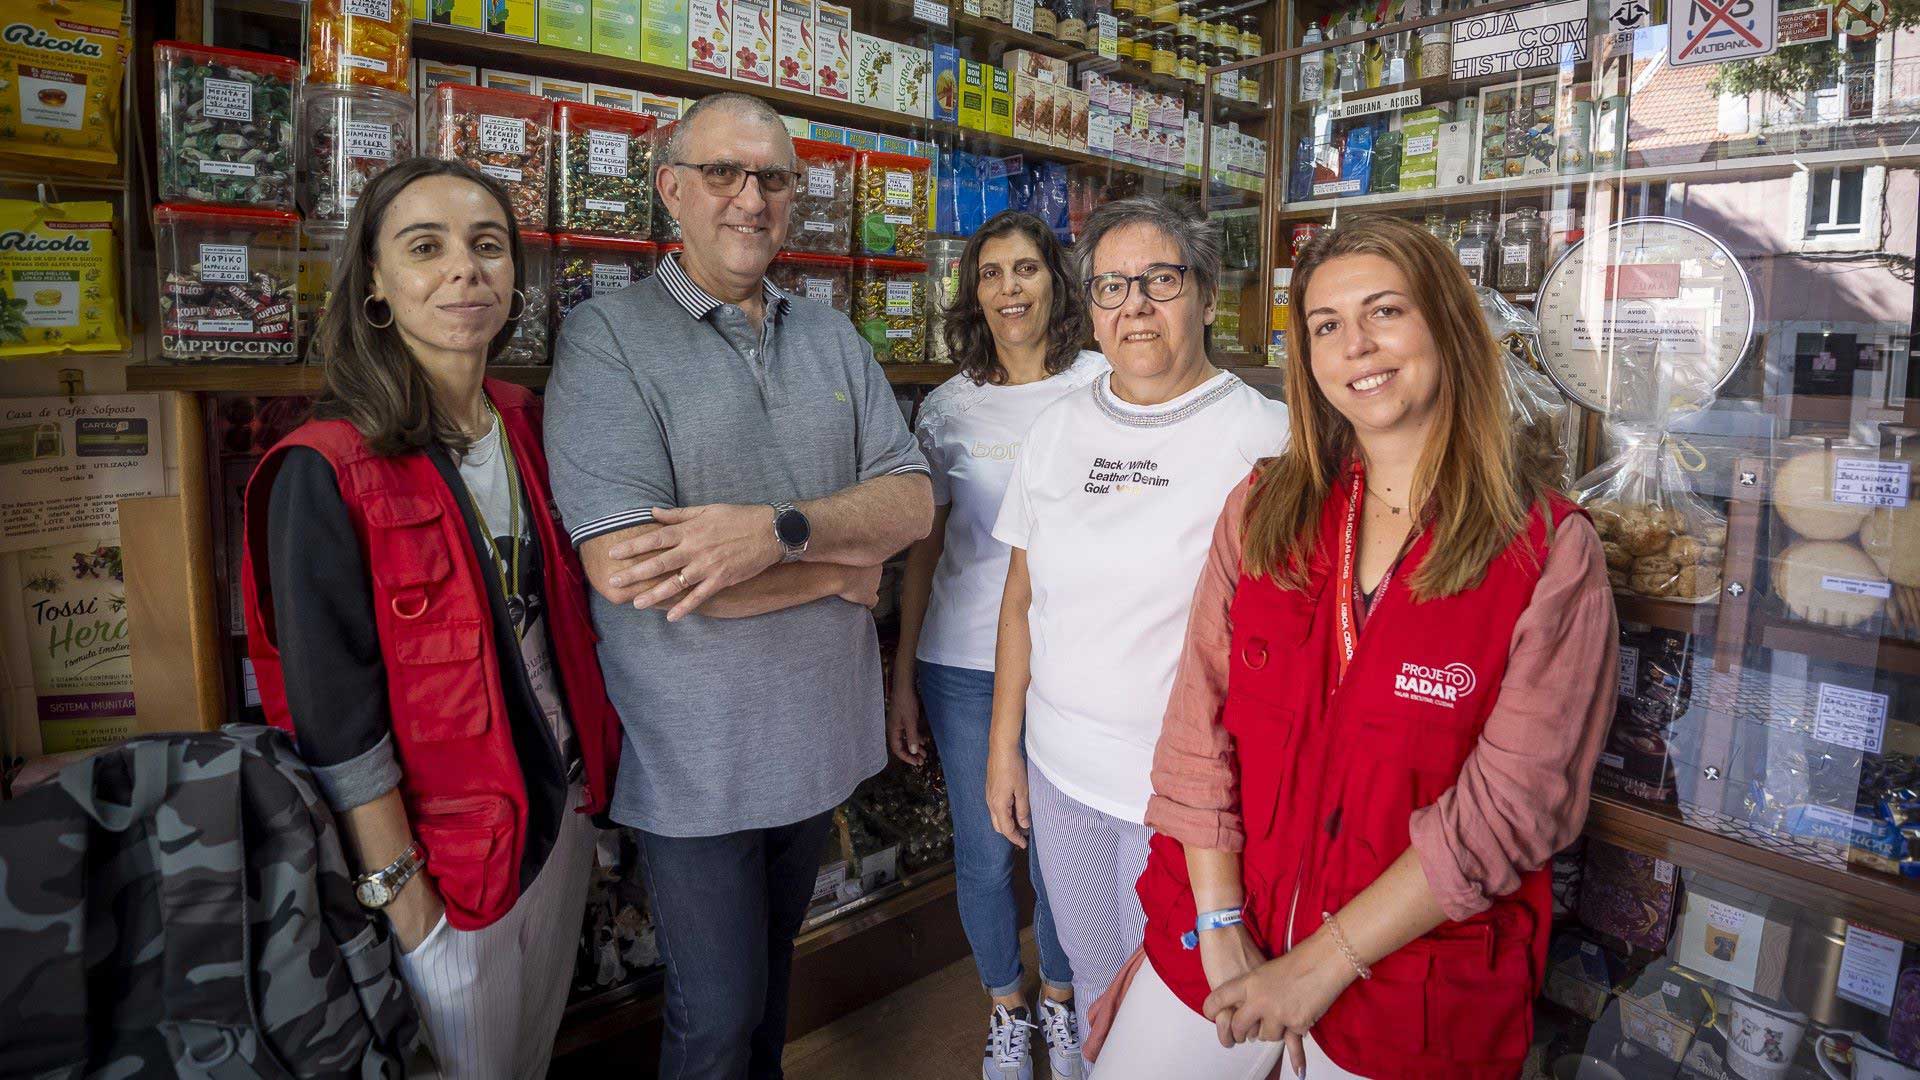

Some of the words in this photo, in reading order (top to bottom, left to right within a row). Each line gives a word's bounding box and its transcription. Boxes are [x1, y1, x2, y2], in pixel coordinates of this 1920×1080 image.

[692, 3, 708, 12] Perda
[736, 15, 750, 23] Perda
[1454, 13, 1520, 43] LOJA
[1518, 18, 1588, 50] COM
[4, 24, 100, 56] Ricola
[1452, 40, 1587, 80] HISTÓRIA
[966, 76, 981, 85] GUIA
[994, 76, 1007, 84] BOM
[208, 88, 238, 96] MENTA
[993, 83, 1008, 92] GUIA
[206, 95, 247, 104] CHOCOLATE
[1346, 100, 1381, 115] GORREANA
[486, 130, 518, 138] RECHEIO
[0, 232, 90, 251] Ricola
[204, 254, 242, 264] KOPIKO
[596, 280, 622, 288] FRUTA
[162, 335, 295, 354] CAPPUCCINO
[6, 410, 32, 420] Casa
[92, 405, 136, 416] Solposto
[94, 461, 138, 469] UTILIZAÇÃO
[1093, 458, 1158, 472] Black/White
[1088, 470, 1170, 488] Leather/Denim
[1084, 482, 1110, 495] Gold.
[1862, 484, 1899, 494] LIMÃO
[84, 494, 102, 502] igual
[32, 597, 98, 625] Tossi
[1402, 662, 1464, 686] PROJETO
[1395, 674, 1458, 702] RADAR
[49, 702, 90, 712] SISTEMA
[1811, 824, 1834, 834] SIN
